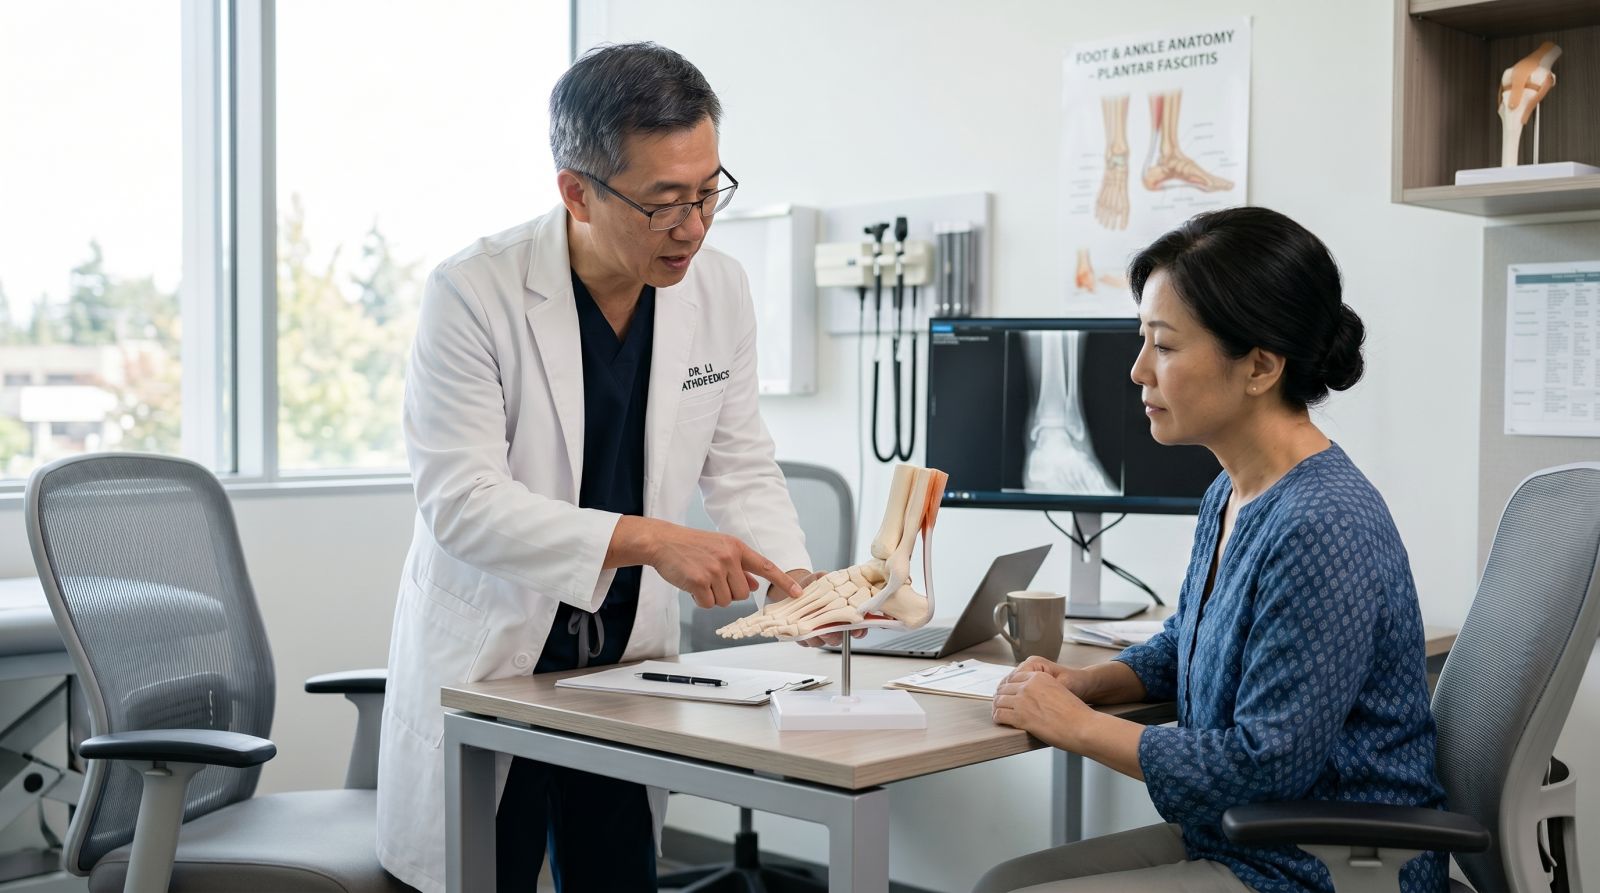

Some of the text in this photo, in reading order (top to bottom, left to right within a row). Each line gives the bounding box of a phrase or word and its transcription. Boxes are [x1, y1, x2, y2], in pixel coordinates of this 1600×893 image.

[1075, 29, 1236, 65] FOOT & ANKLE ANATOMY
[1097, 60, 1155, 80] PLANTAR
[704, 363, 714, 373] LI
